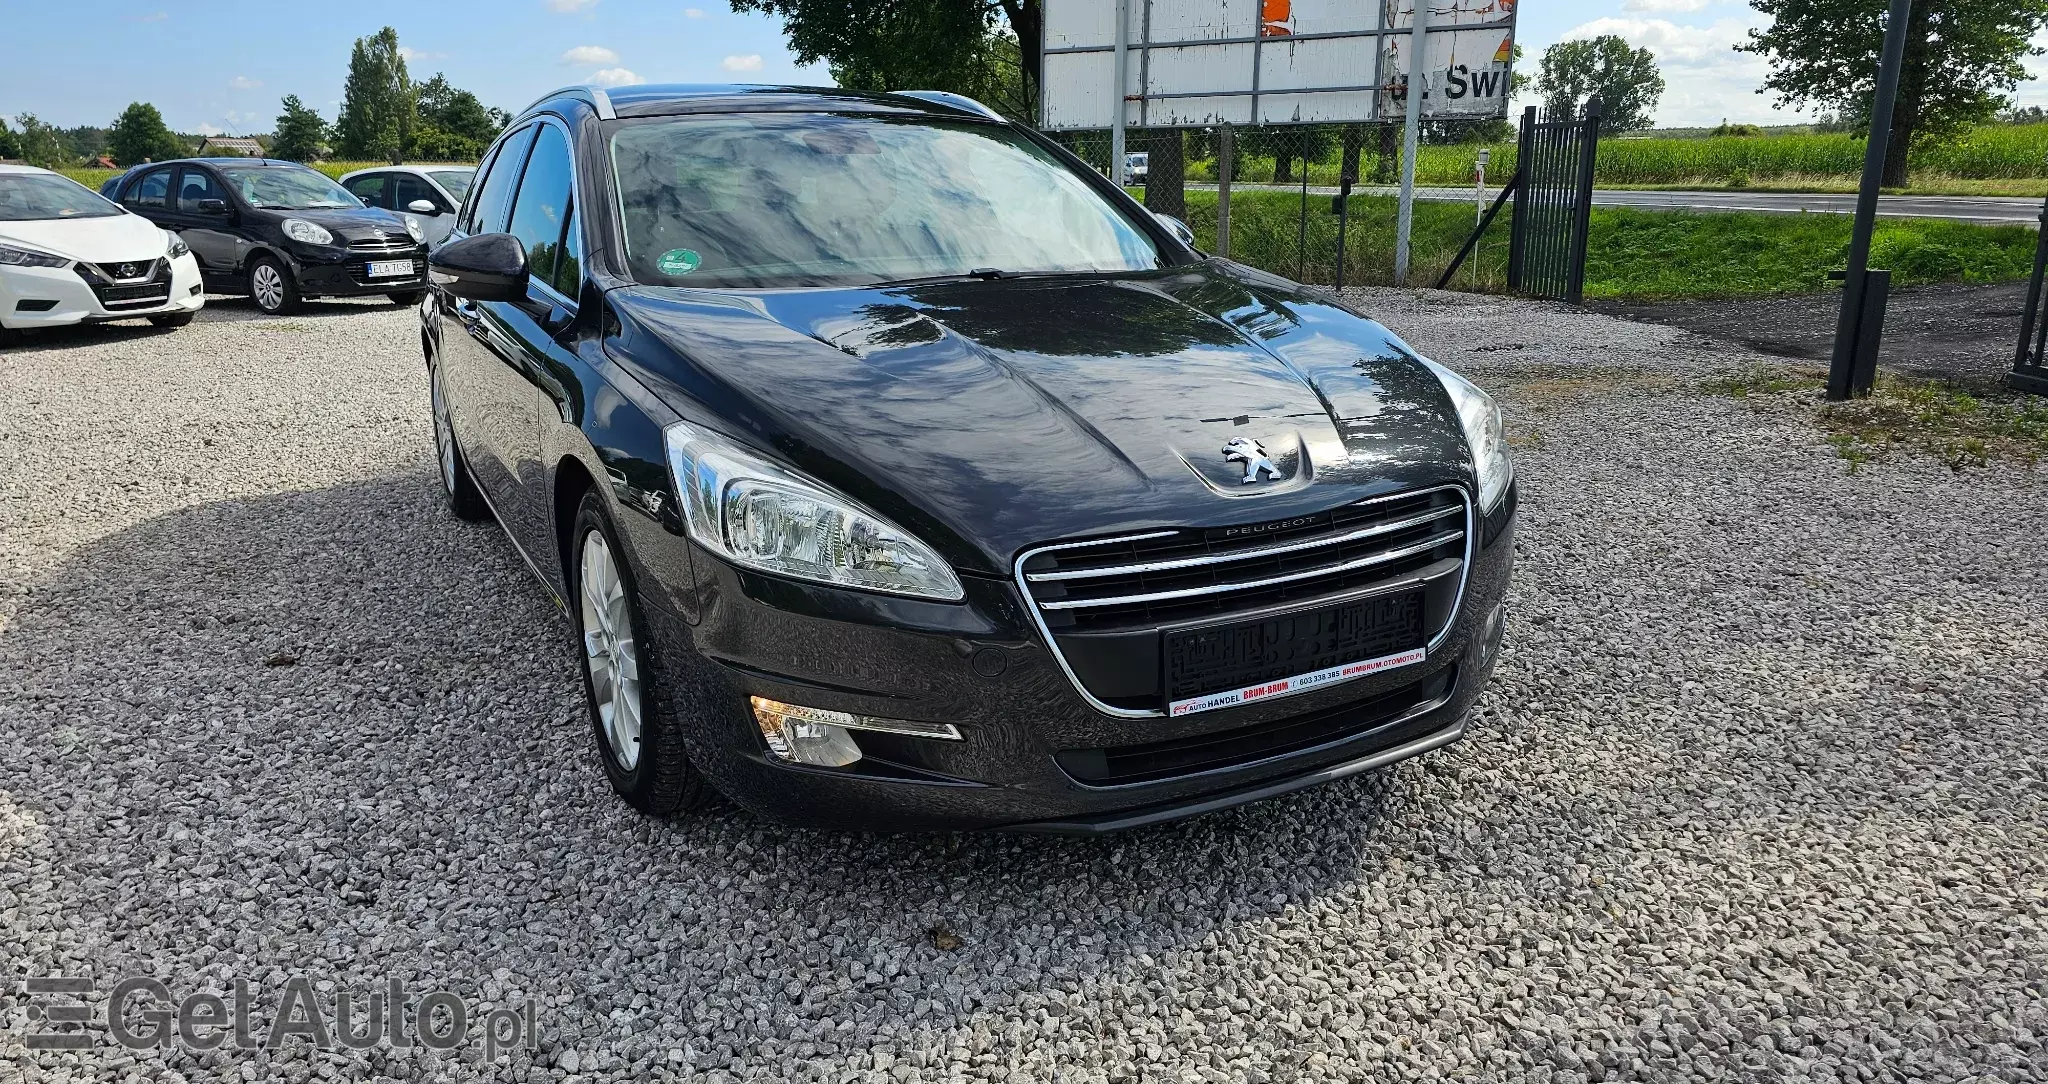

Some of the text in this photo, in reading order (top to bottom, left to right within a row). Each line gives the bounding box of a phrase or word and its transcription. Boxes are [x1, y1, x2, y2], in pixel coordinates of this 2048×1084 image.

[373, 264, 390, 274] ELA
[1226, 516, 1316, 536] PEUGEOT
[1188, 652, 1424, 712] AUTO HANDEL BRUM-BRUM 603 338 385 BRUMBRUM.OTOMOTO.PL
